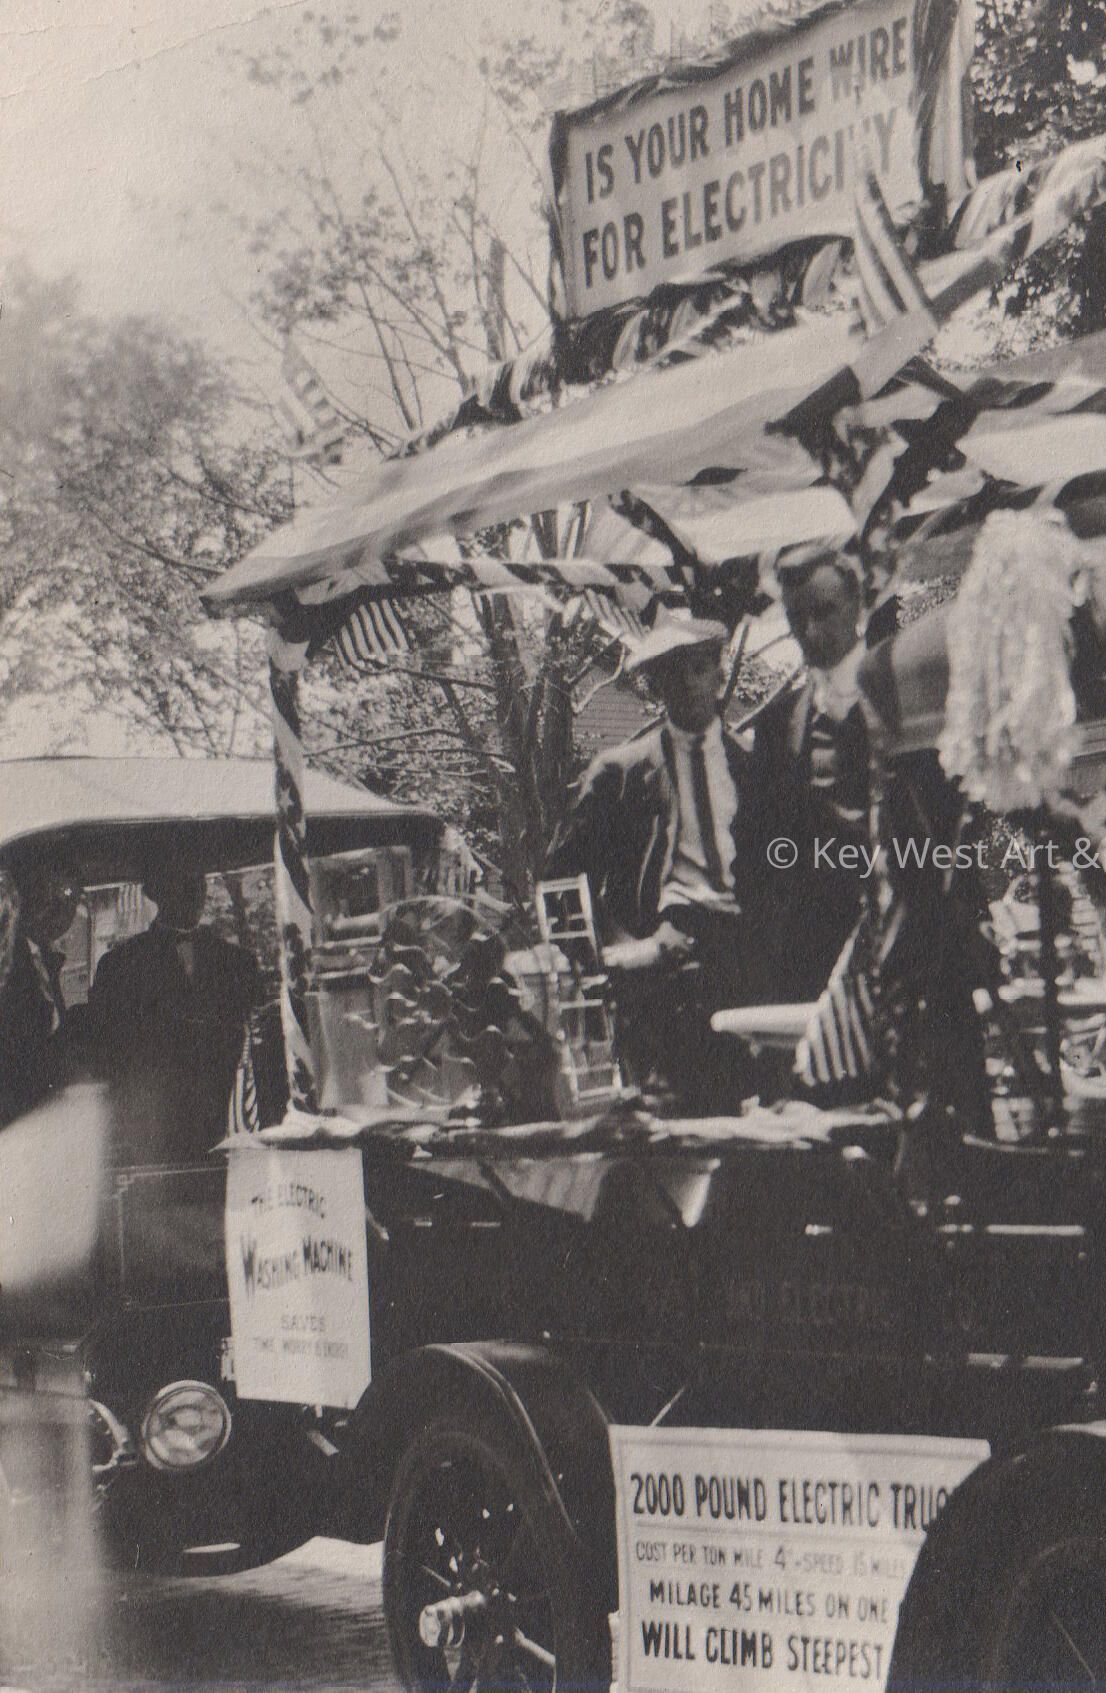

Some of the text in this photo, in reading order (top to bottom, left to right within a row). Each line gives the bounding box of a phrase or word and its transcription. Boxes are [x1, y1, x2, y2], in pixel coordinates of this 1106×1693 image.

[585, 144, 615, 203] IS
[624, 105, 710, 184] YOUR
[723, 57, 816, 147] HOME
[582, 212, 646, 289] FOR
[278, 1182, 326, 1220] ELECTRIC
[240, 1233, 353, 1299] WASHING MACHINE
[630, 1472, 949, 1531] 2000 POUND ELECTRIC TRUC
[636, 1541, 667, 1562] COST
[673, 1542, 697, 1564] PER
[702, 1544, 726, 1566] TON
[734, 1549, 763, 1568] MILE
[649, 1579, 888, 1624] MILAGE 45 MILES ON ONE
[641, 1620, 884, 1681] WILL CLIMB STEEPEST
